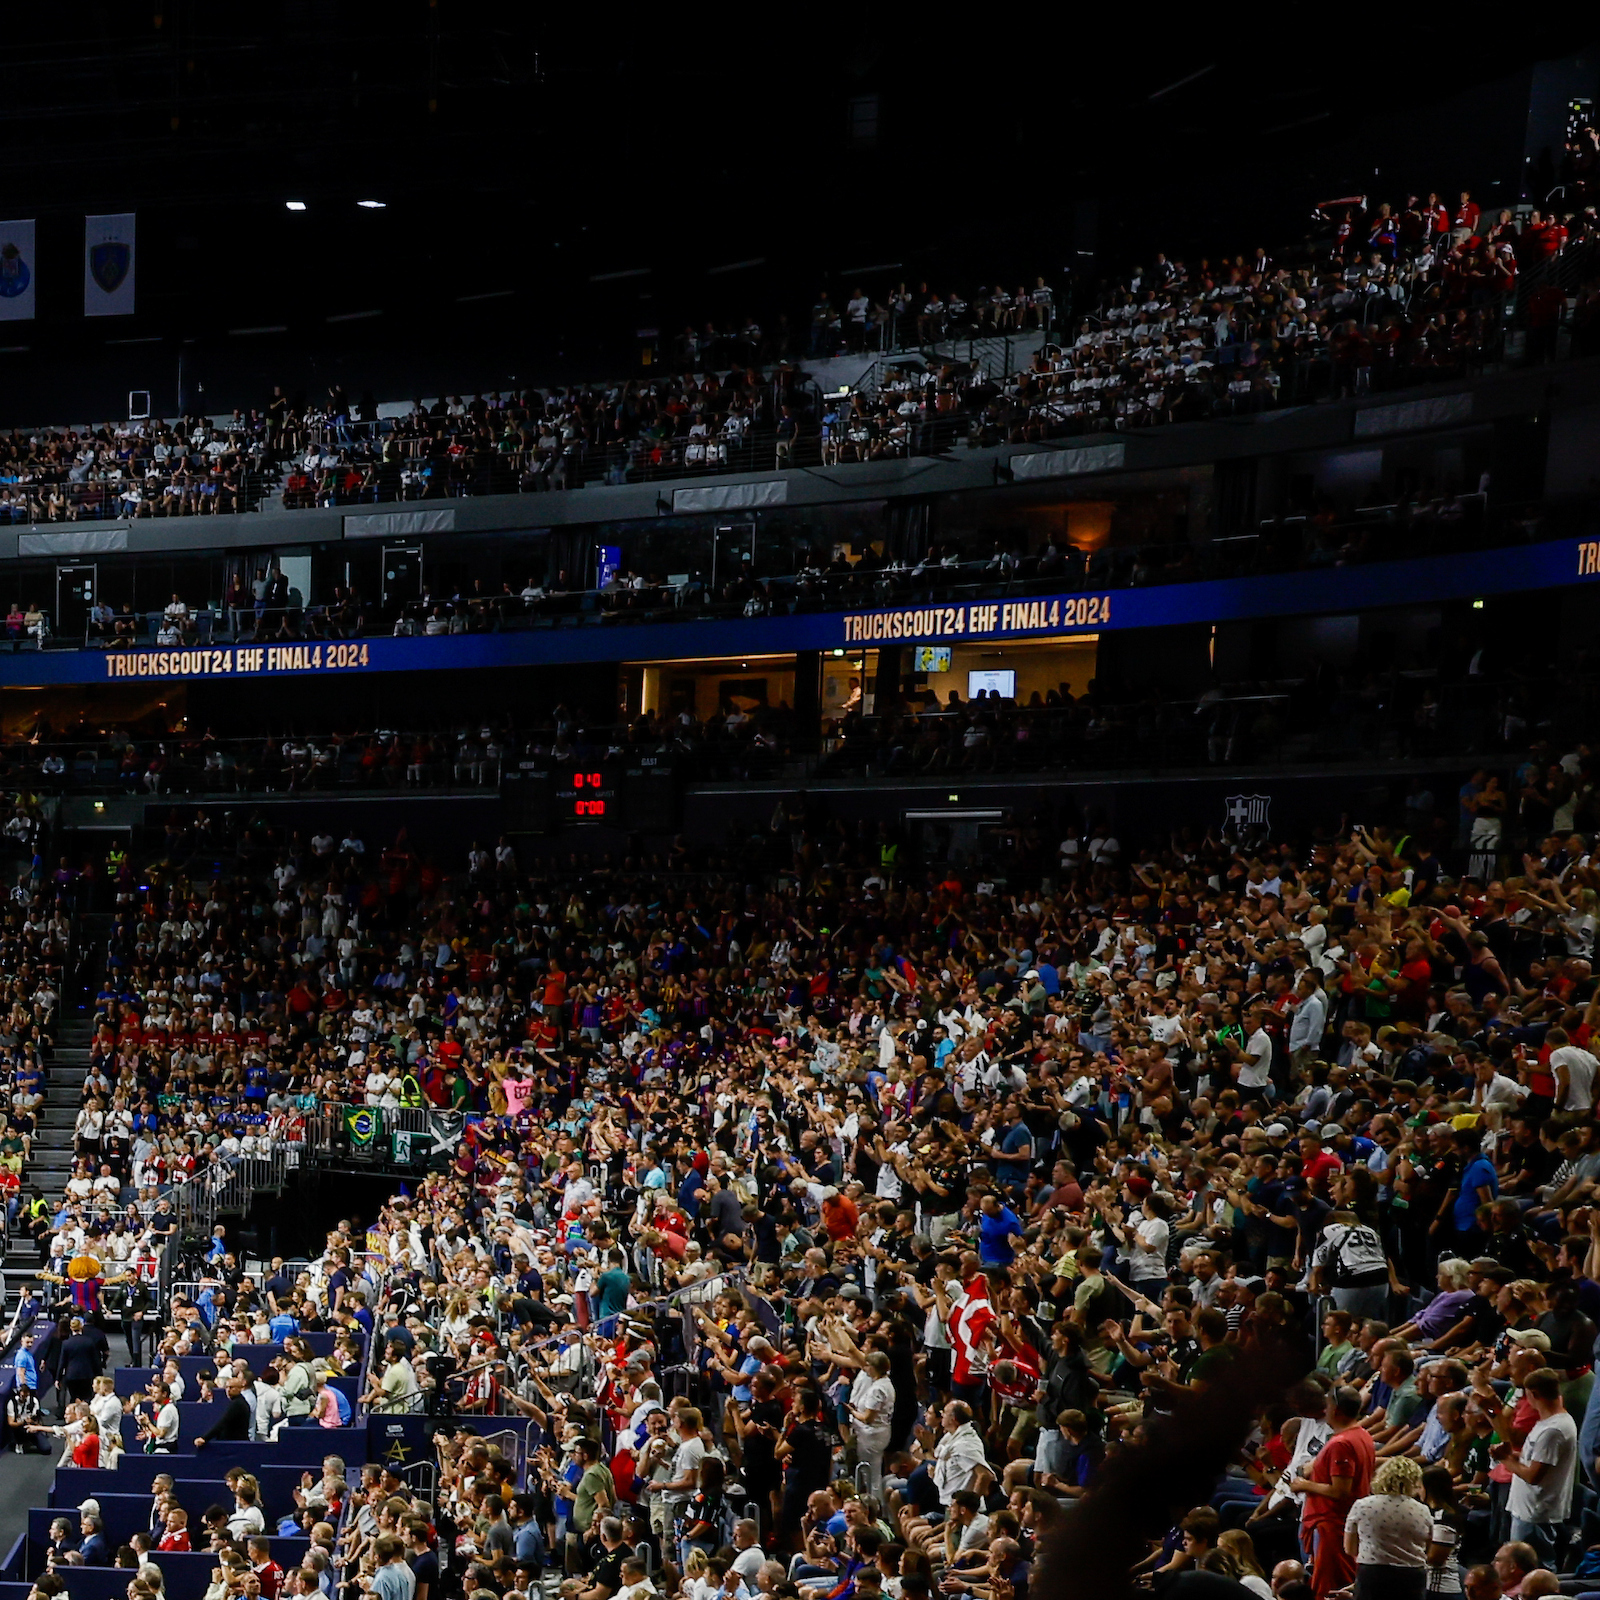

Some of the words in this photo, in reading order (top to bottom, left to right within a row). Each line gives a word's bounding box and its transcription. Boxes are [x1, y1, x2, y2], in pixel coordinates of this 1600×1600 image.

[843, 607, 966, 642] TRUCKSCOUT24
[969, 604, 999, 633] EHF
[1001, 600, 1060, 631] FINAL4
[1064, 596, 1110, 626] 2024
[105, 649, 233, 677] TRUCKSCOUT24
[236, 648, 264, 672] EHF
[267, 645, 322, 671] FINAL4
[326, 643, 369, 668] 2024
